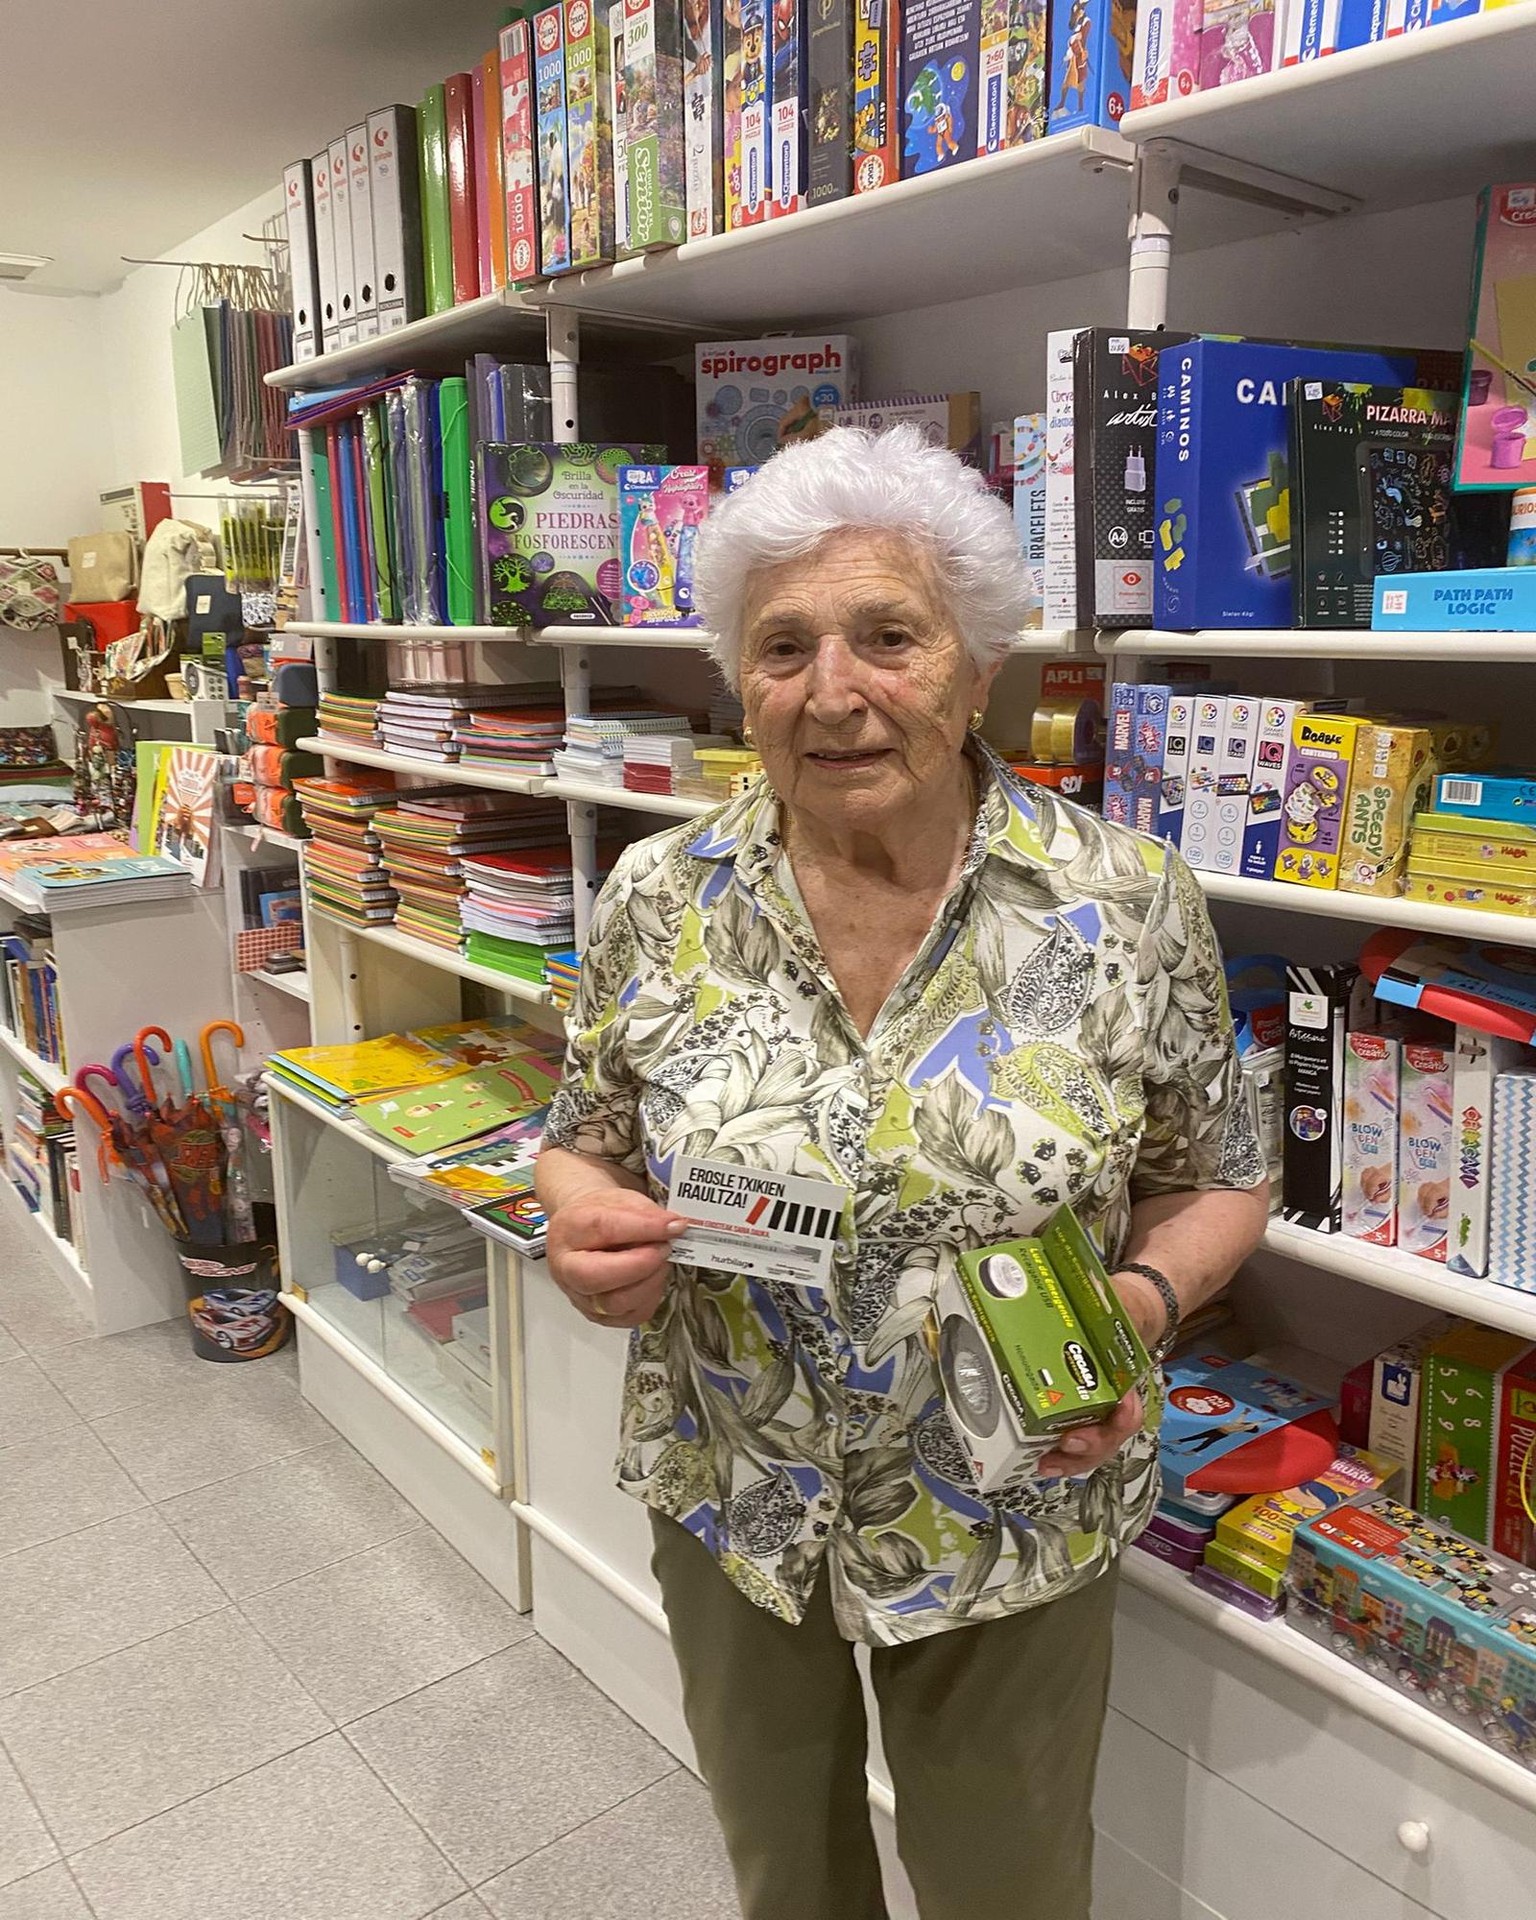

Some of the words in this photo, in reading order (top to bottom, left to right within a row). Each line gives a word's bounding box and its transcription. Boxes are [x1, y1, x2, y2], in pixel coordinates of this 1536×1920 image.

[1305, 0, 1320, 46] Clemen
[628, 22, 649, 47] 300
[568, 47, 592, 70] 1000
[538, 60, 561, 82] 1000
[1180, 74, 1191, 89] 6+
[777, 104, 794, 121] 104
[990, 81, 998, 138] Clementoni
[1109, 94, 1124, 115] 6+
[745, 112, 761, 128] 104
[635, 147, 651, 241] Senior
[812, 183, 833, 199] 1000
[514, 193, 525, 233] 1000
[701, 344, 842, 378] spirograph
[1103, 389, 1138, 400] Alex
[1236, 378, 1287, 406] CA
[1106, 403, 1158, 428] artist
[1178, 357, 1192, 462] CAMINOS
[1366, 405, 1427, 424] PIZARRA
[561, 470, 592, 481] Brilla
[569, 482, 579, 490] en
[580, 481, 588, 490] la
[553, 490, 604, 501] Oscuridad
[536, 512, 619, 529] PIEDRAS
[1030, 489, 1046, 560] BRACELETS
[1111, 531, 1127, 543] A4
[1434, 589, 1472, 601] PATH
[1474, 588, 1513, 600] PATH
[1447, 603, 1497, 615] LOGIC
[1045, 670, 1083, 684] APLI
[1114, 710, 1131, 750] MARVEL
[1169, 738, 1184, 749] IQ
[1260, 741, 1283, 761] IQ
[1259, 761, 1281, 769] WAVES
[1060, 775, 1082, 794] SDI
[1137, 797, 1153, 834] MARVE
[1352, 794, 1371, 844] ANTS
[1366, 786, 1392, 857] SPEEDY
[1501, 847, 1528, 858] HABA
[1351, 1123, 1383, 1138] BLOW
[1408, 1137, 1442, 1152] BLOW
[688, 1167, 734, 1188] EROSLE
[738, 1175, 787, 1198] TXIKIEN
[677, 1181, 749, 1209] IRAULTZA!
[1374, 1231, 1387, 1243] 5+
[1029, 1247, 1042, 1265] Luz
[1038, 1264, 1049, 1277] de
[1043, 1275, 1076, 1329] Emergencia
[1068, 1343, 1097, 1390] CEGASA
[1440, 1367, 1458, 1377] 5
[1036, 1389, 1051, 1410] V16
[1075, 1384, 1090, 1401] LED
[1440, 1389, 1458, 1405] 7
[1465, 1388, 1484, 1400] 6
[1438, 1417, 1455, 1431] 9
[1463, 1418, 1482, 1428] 8
[1252, 1504, 1280, 1521] 100
